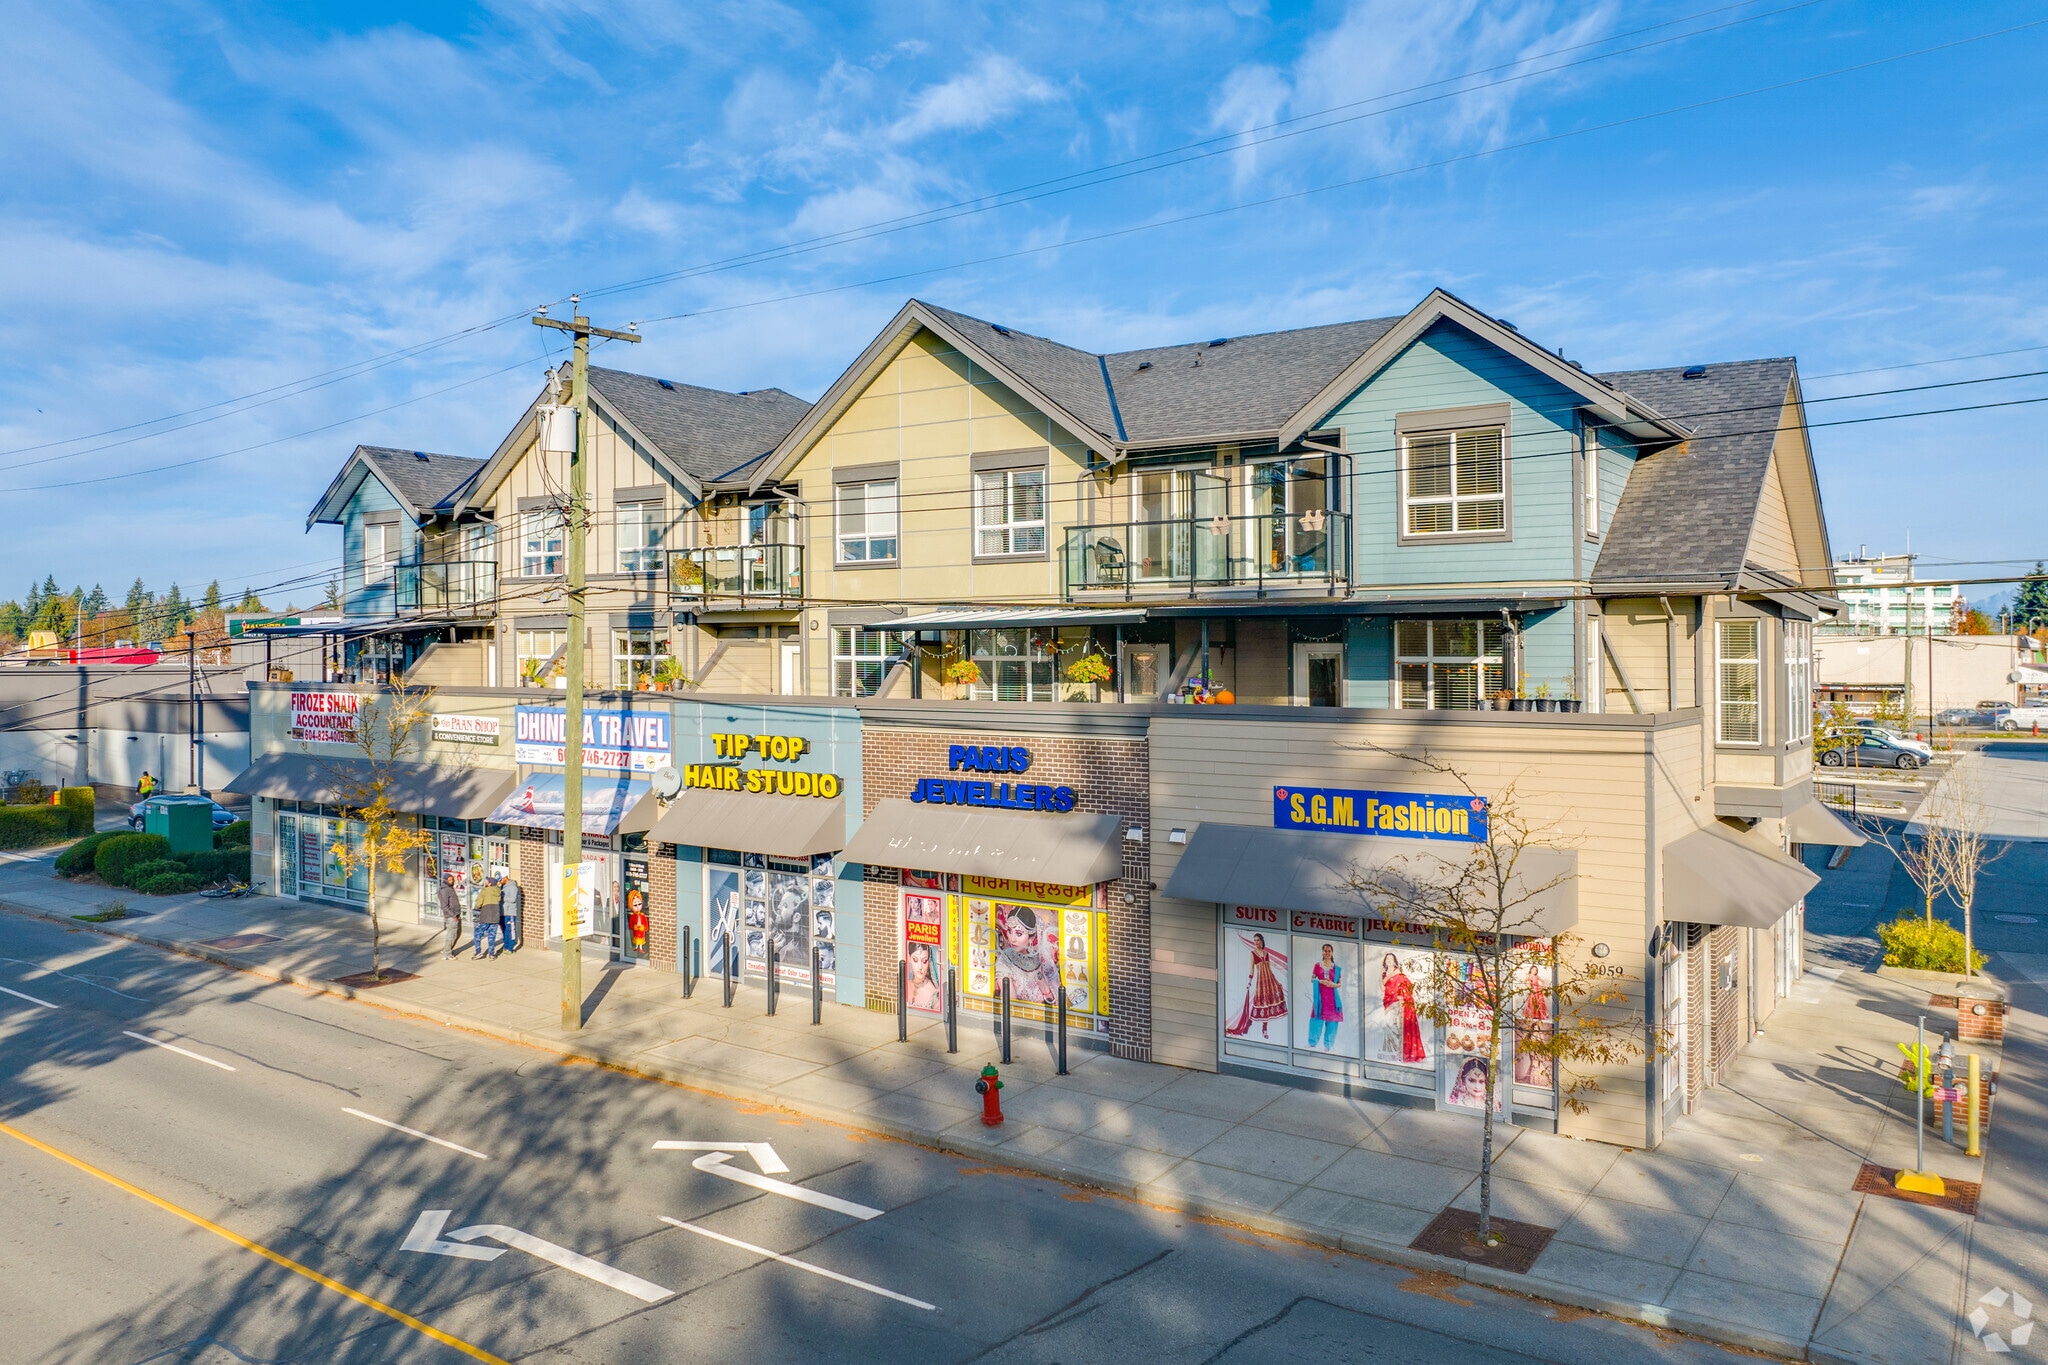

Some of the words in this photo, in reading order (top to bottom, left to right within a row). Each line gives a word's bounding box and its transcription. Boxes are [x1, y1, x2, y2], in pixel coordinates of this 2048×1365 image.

[291, 693, 325, 712] FIROZE
[327, 694, 358, 713] SHAIK
[296, 713, 353, 729] ACCOUNTANT
[451, 717, 472, 731] PAAN
[475, 718, 498, 733] SHOP
[305, 729, 345, 743] 604-825-4005
[439, 733, 477, 743] CONVENIENCE
[477, 735, 494, 744] STORE
[517, 711, 595, 744] DHINDA
[599, 715, 668, 749] TRAVEL
[711, 733, 749, 757] TIP
[755, 735, 803, 760] TOP
[949, 745, 1029, 772] PARIS
[684, 764, 740, 791] HAIR
[746, 769, 838, 798] STUDIO
[911, 779, 1074, 811] JEWELLERS
[1290, 793, 1359, 827] S.G.M.
[1367, 799, 1468, 834] Fashion
[1236, 905, 1277, 922] SUITS
[908, 922, 938, 936] PARIS
[1294, 915, 1306, 927] &
[1310, 917, 1355, 932] FABRIC
[908, 932, 938, 943] Jewellers
[1448, 1009, 1470, 1018] OPEN
